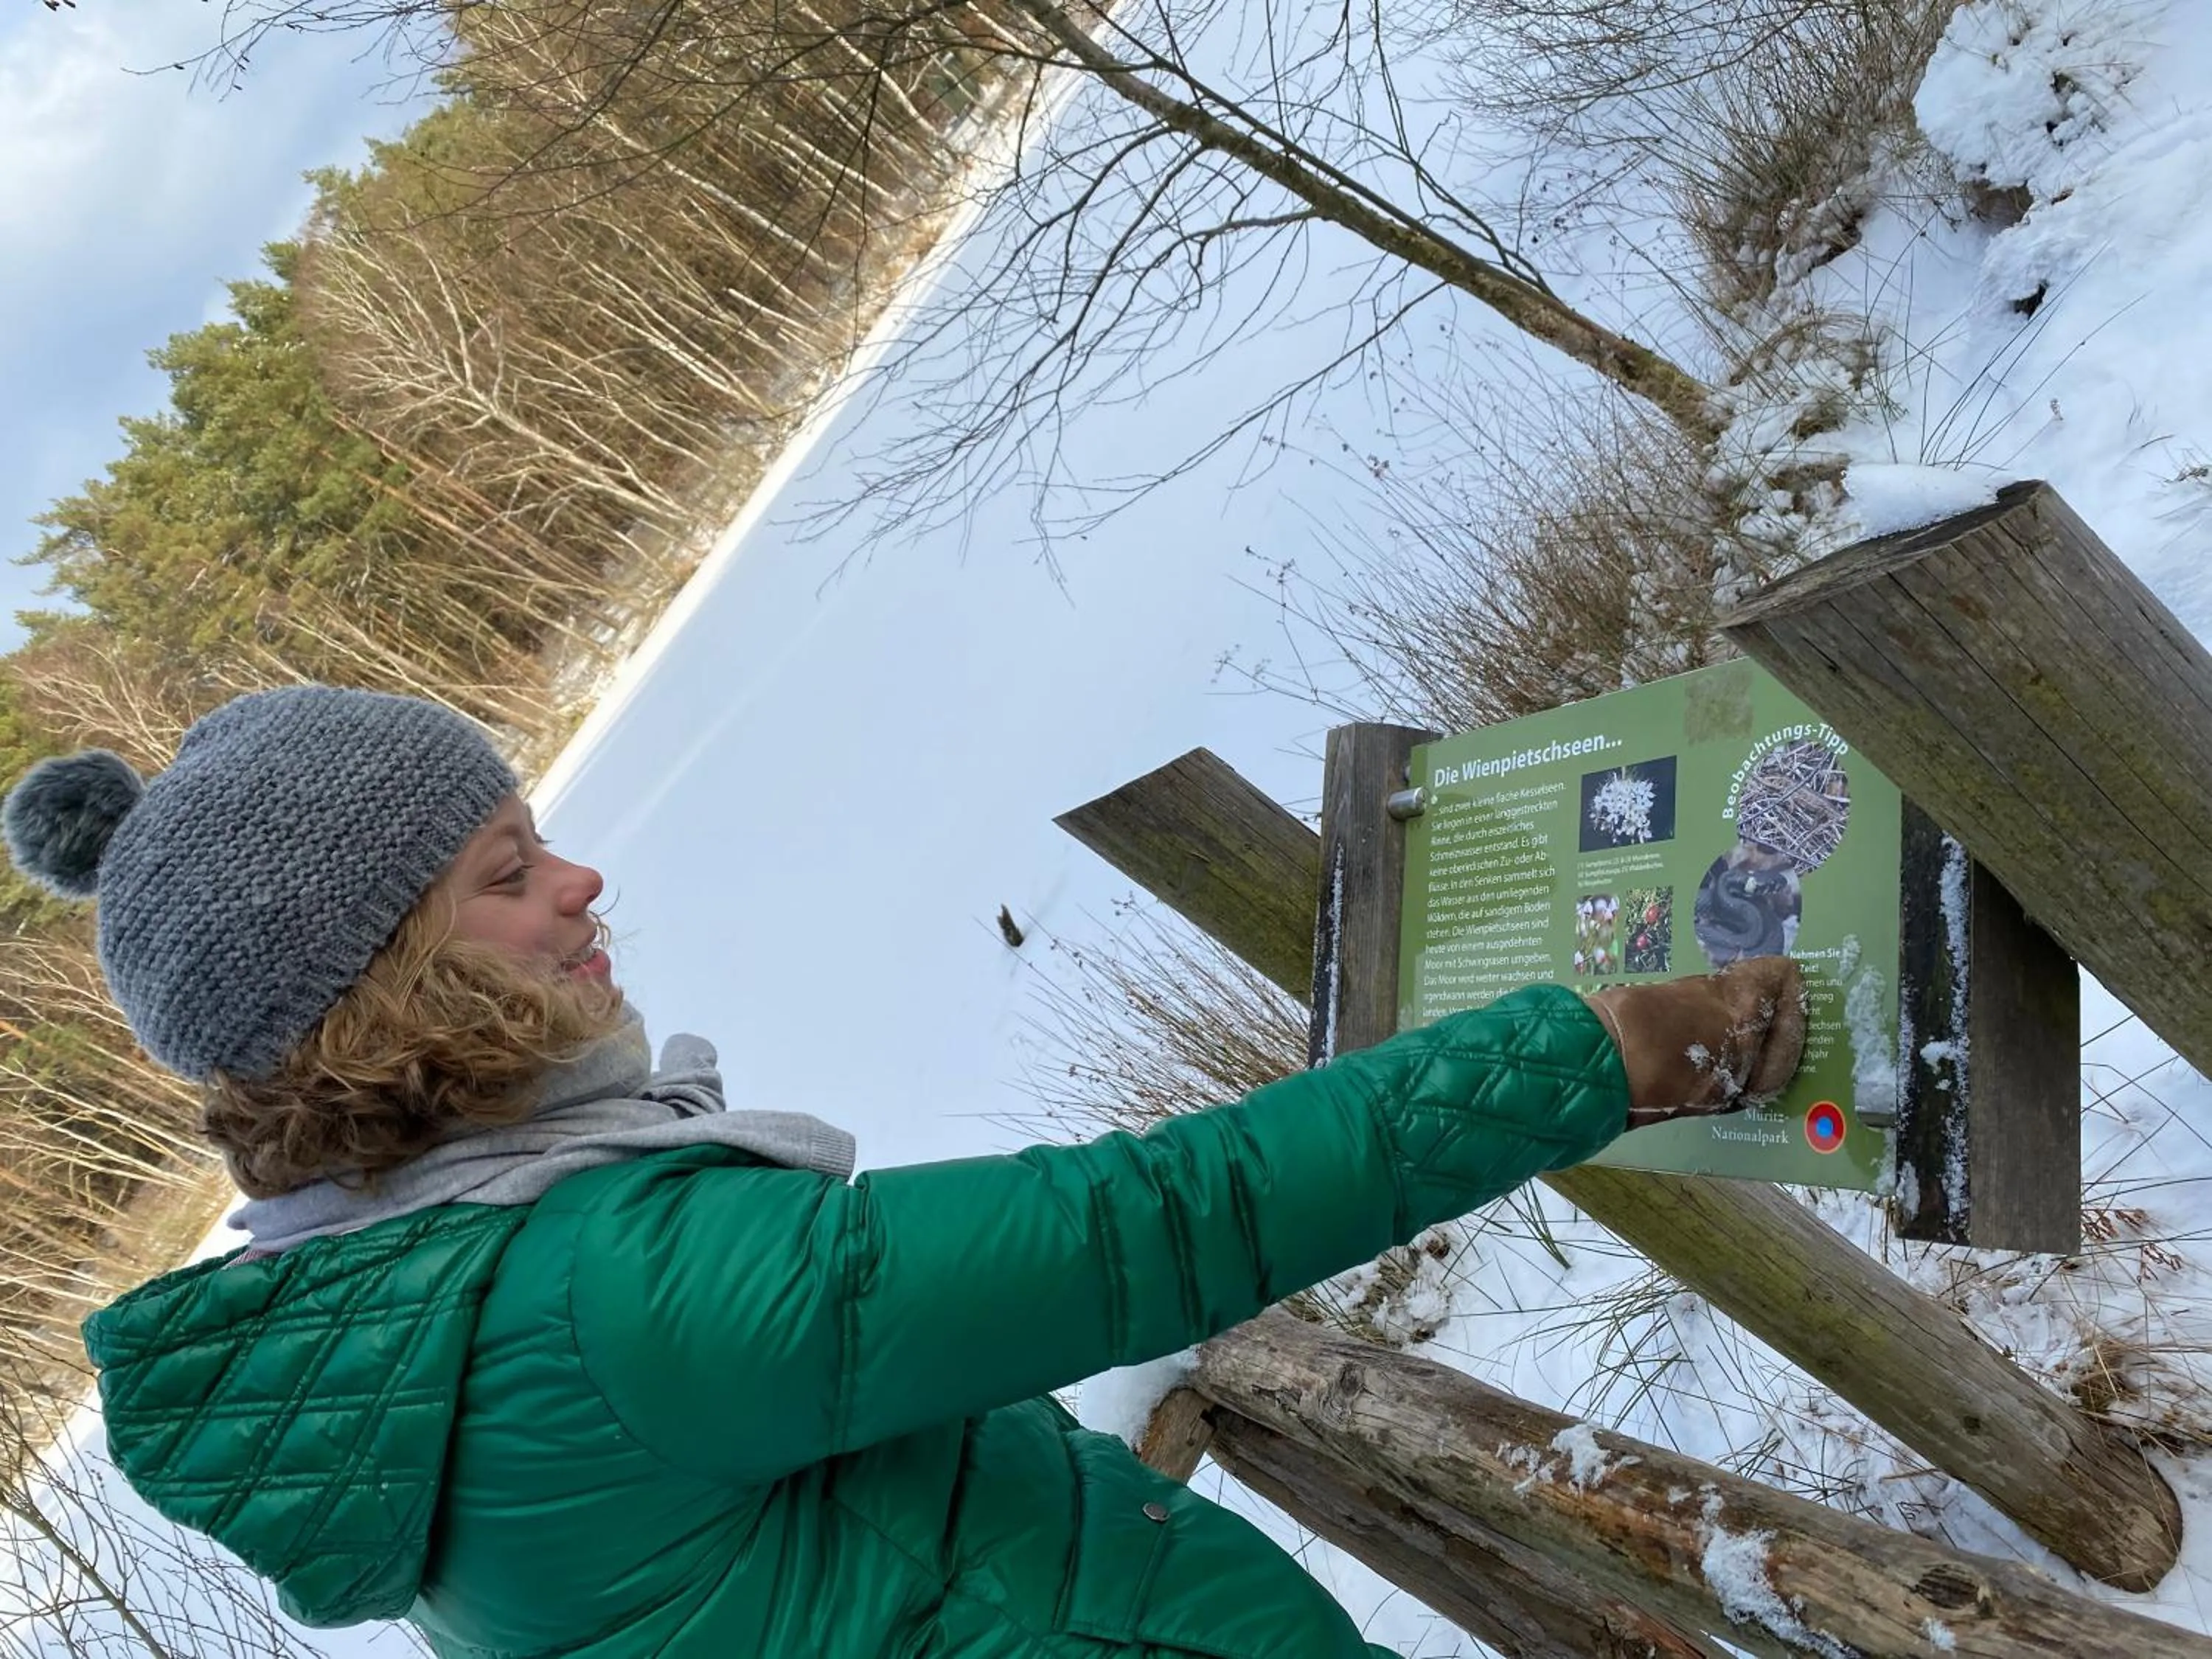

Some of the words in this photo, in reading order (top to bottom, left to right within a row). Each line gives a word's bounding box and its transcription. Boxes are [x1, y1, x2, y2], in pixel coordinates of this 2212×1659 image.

[1434, 768, 1459, 787] Die
[1462, 734, 1622, 782] Wienpietschseen...
[1722, 723, 1848, 819] Beobachtungs-Tipp
[1439, 804, 1453, 815] sind
[1521, 836, 1529, 847] Es
[1531, 833, 1548, 848] gibt
[1514, 852, 1534, 865] oder
[1475, 873, 1502, 886] Senken
[1503, 867, 1537, 883] sammelt
[1538, 864, 1555, 877] sich
[1458, 908, 1470, 920] die
[1471, 907, 1484, 919] auf
[1523, 900, 1551, 914] Boden
[1452, 925, 1464, 936] Die
[1531, 917, 1549, 928] sind
[1790, 949, 1825, 960] Nehmen
[1827, 947, 1841, 959] Sie
[1425, 959, 1443, 970] Moor
[1439, 974, 1457, 985] Moor
[1537, 969, 1554, 980] und
[1711, 1126, 1790, 1146] Nationalpark
